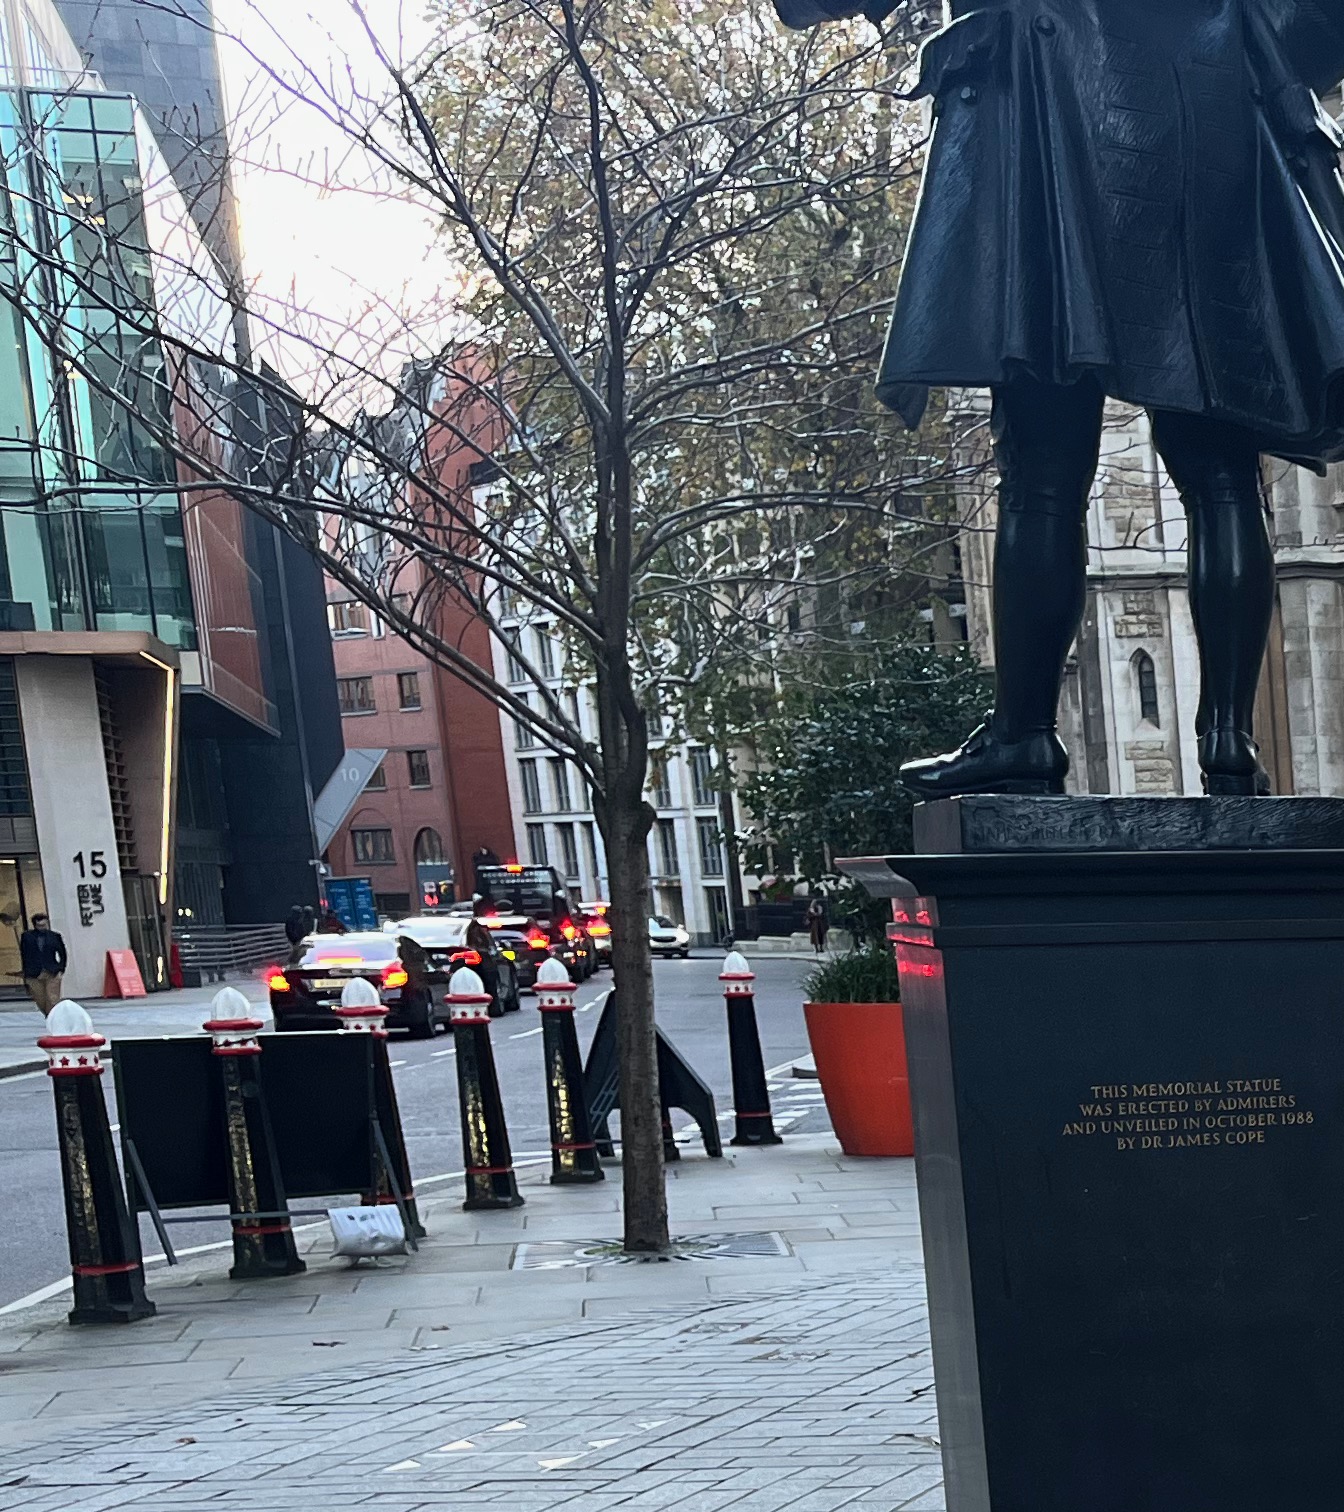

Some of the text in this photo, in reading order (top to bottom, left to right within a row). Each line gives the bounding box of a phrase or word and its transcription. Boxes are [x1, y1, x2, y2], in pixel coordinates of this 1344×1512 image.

[340, 768, 360, 782] 10
[73, 851, 107, 878] 15
[77, 884, 94, 927] FETTER
[89, 883, 105, 914] LANE
[1091, 1078, 1282, 1099] THIS MEMORIAL STATUE
[1079, 1095, 1296, 1117] WAS ERECTED BY ADMIRERS
[1062, 1111, 1314, 1136] AND UNVEILED IN OCTOBER 1988
[1117, 1131, 1266, 1150] BY DR JAMES COPE
